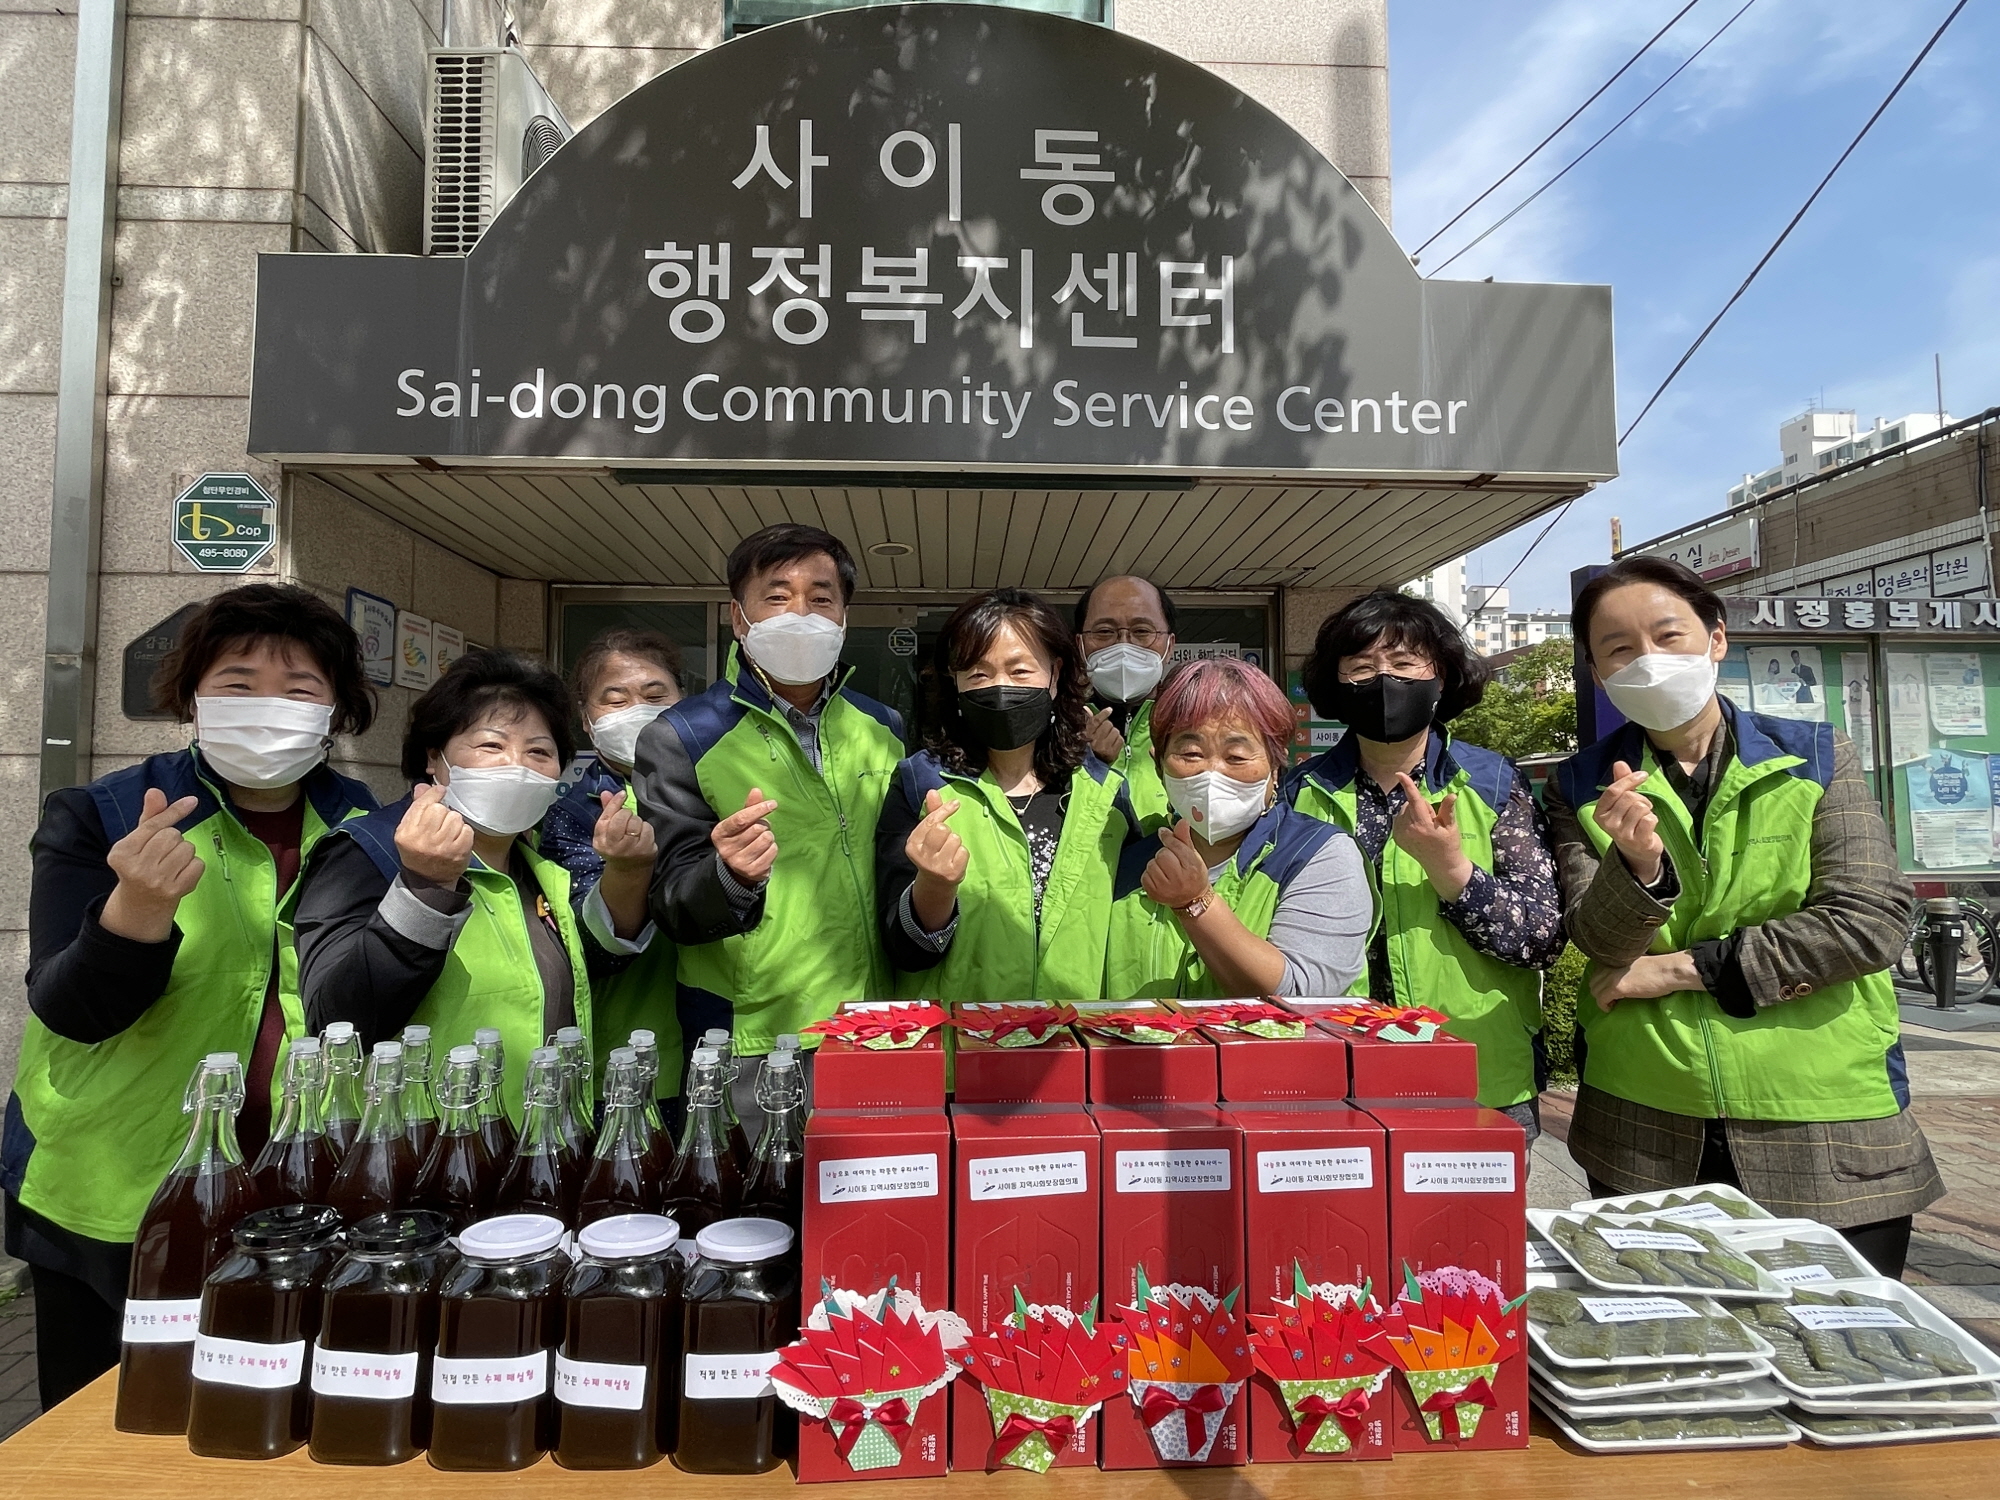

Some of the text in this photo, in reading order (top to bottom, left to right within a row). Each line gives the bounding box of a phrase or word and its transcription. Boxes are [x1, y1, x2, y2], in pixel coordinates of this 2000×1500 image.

[644, 241, 1234, 354] 행정복지센터
[396, 368, 1468, 439] Sai-dong Community Service Center
[236, 524, 261, 537] Cop
[199, 548, 248, 558] 495-8080
[1316, 732, 1340, 742] 사이동
[1143, 1176, 1163, 1184] 사이동
[1284, 1175, 1305, 1184] 사이동
[1430, 1176, 1449, 1185] 사이동
[847, 1185, 868, 1193] 사이동
[997, 1181, 1017, 1190] 사이동
[218, 1353, 234, 1364] 만든
[331, 1365, 348, 1377] 만든
[721, 1369, 738, 1380] 만든
[462, 1373, 479, 1385] 만든
